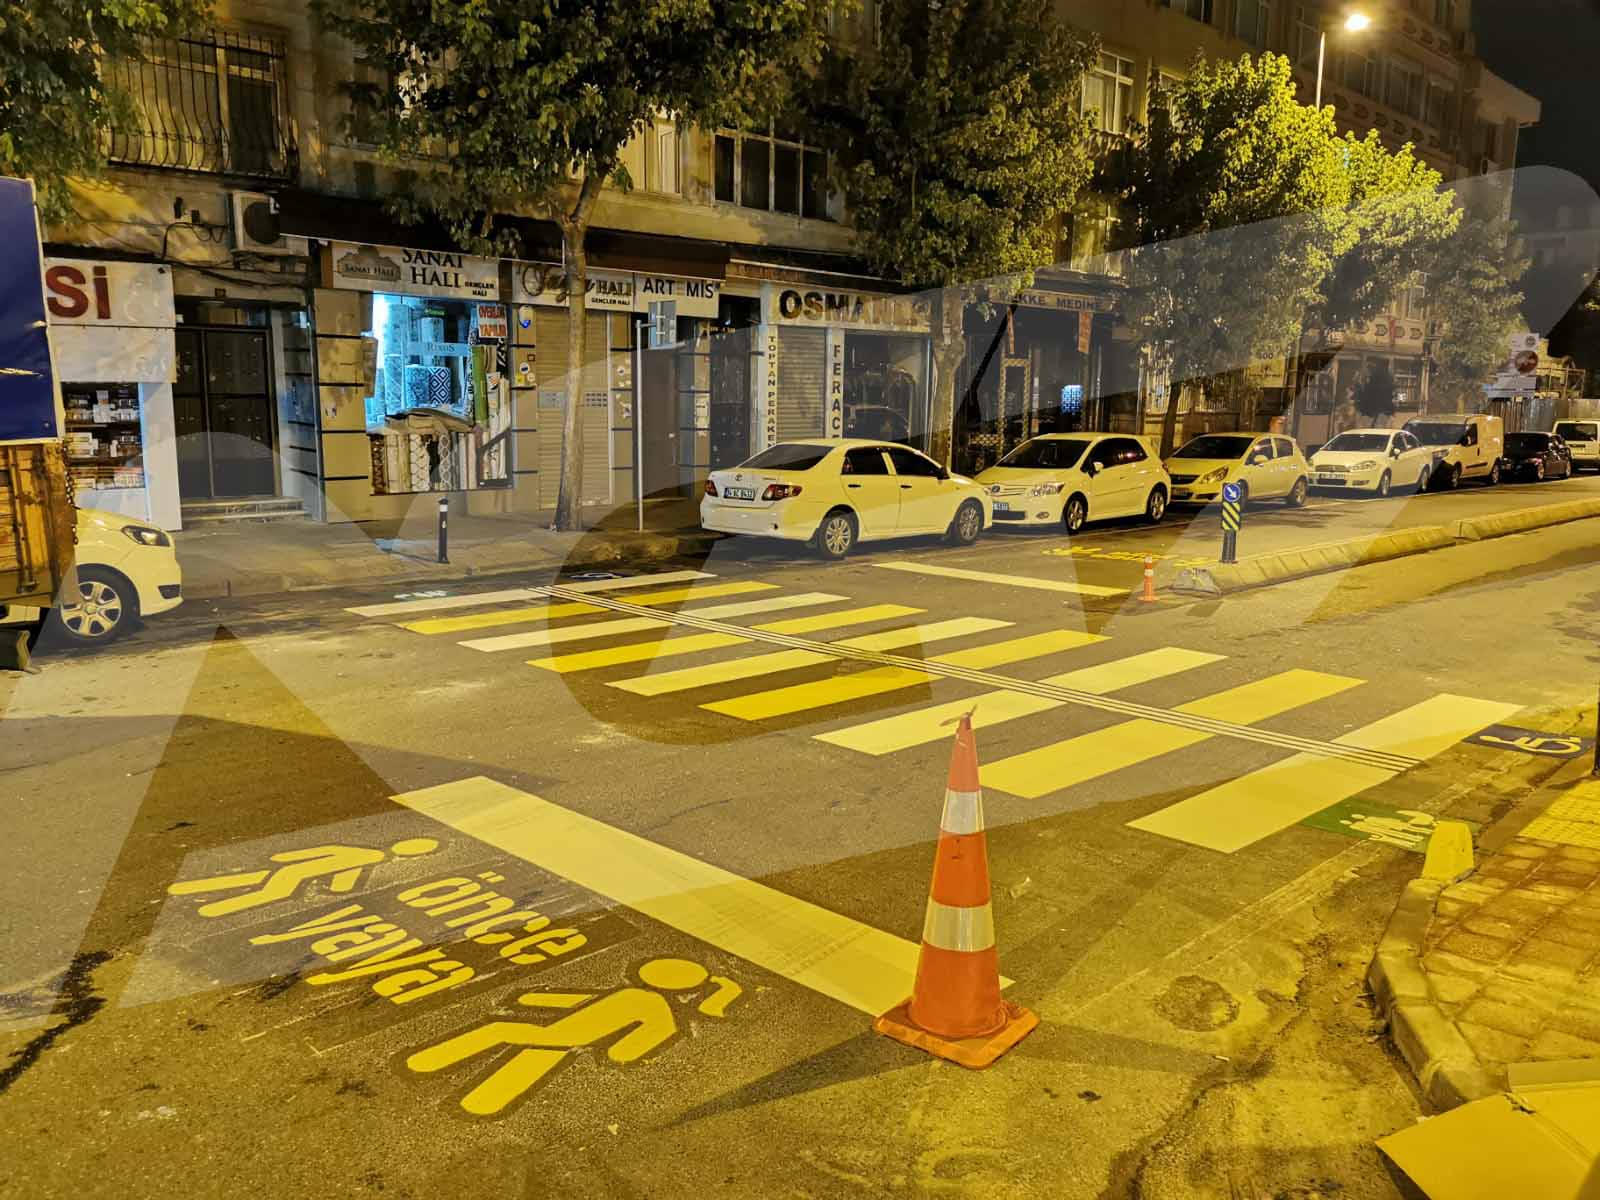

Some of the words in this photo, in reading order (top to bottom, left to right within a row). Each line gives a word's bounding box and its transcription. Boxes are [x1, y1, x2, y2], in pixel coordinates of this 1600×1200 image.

[401, 248, 464, 269] SANAT
[411, 266, 462, 289] HALI
[596, 279, 632, 297] HALI
[768, 336, 776, 387] TOPTAN
[832, 344, 841, 438] FERAC
[398, 871, 588, 964] önce
[250, 905, 475, 1004] yaya
